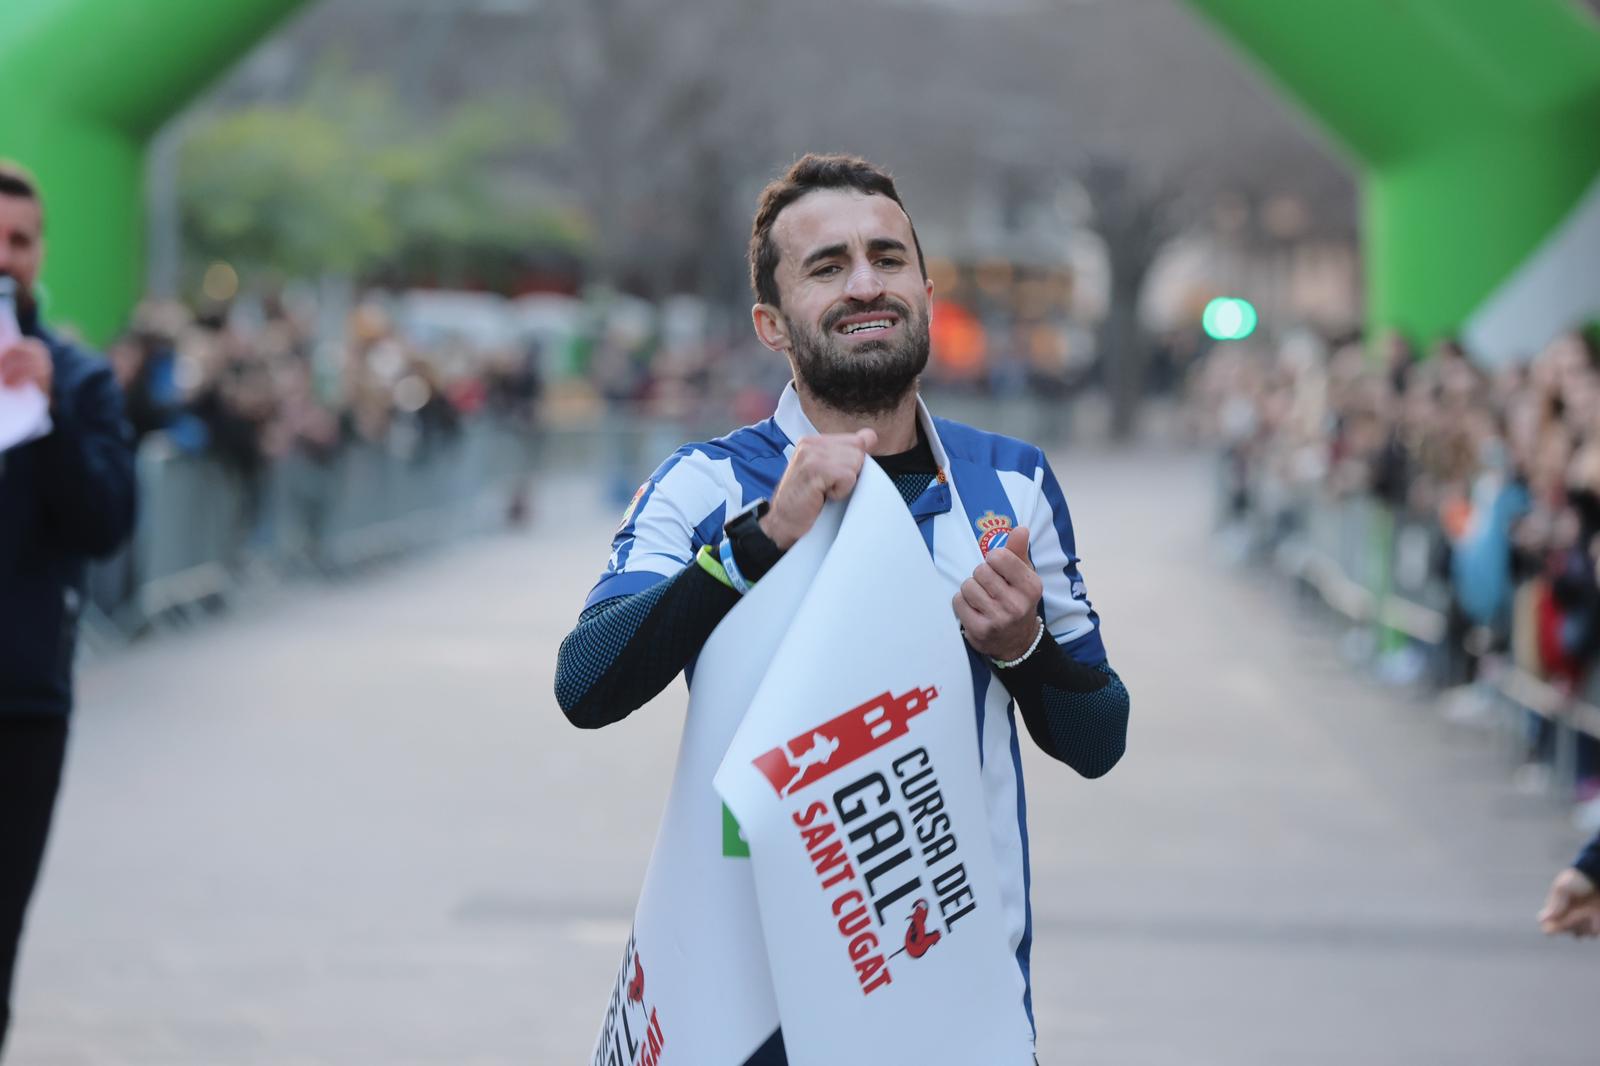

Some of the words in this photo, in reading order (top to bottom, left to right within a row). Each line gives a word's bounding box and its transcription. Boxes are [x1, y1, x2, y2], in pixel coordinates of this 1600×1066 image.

[792, 801, 855, 890] SANT
[832, 890, 892, 995] CUGAT
[832, 771, 922, 926] GALL
[892, 747, 957, 867] CURSA
[932, 862, 976, 934] DEL
